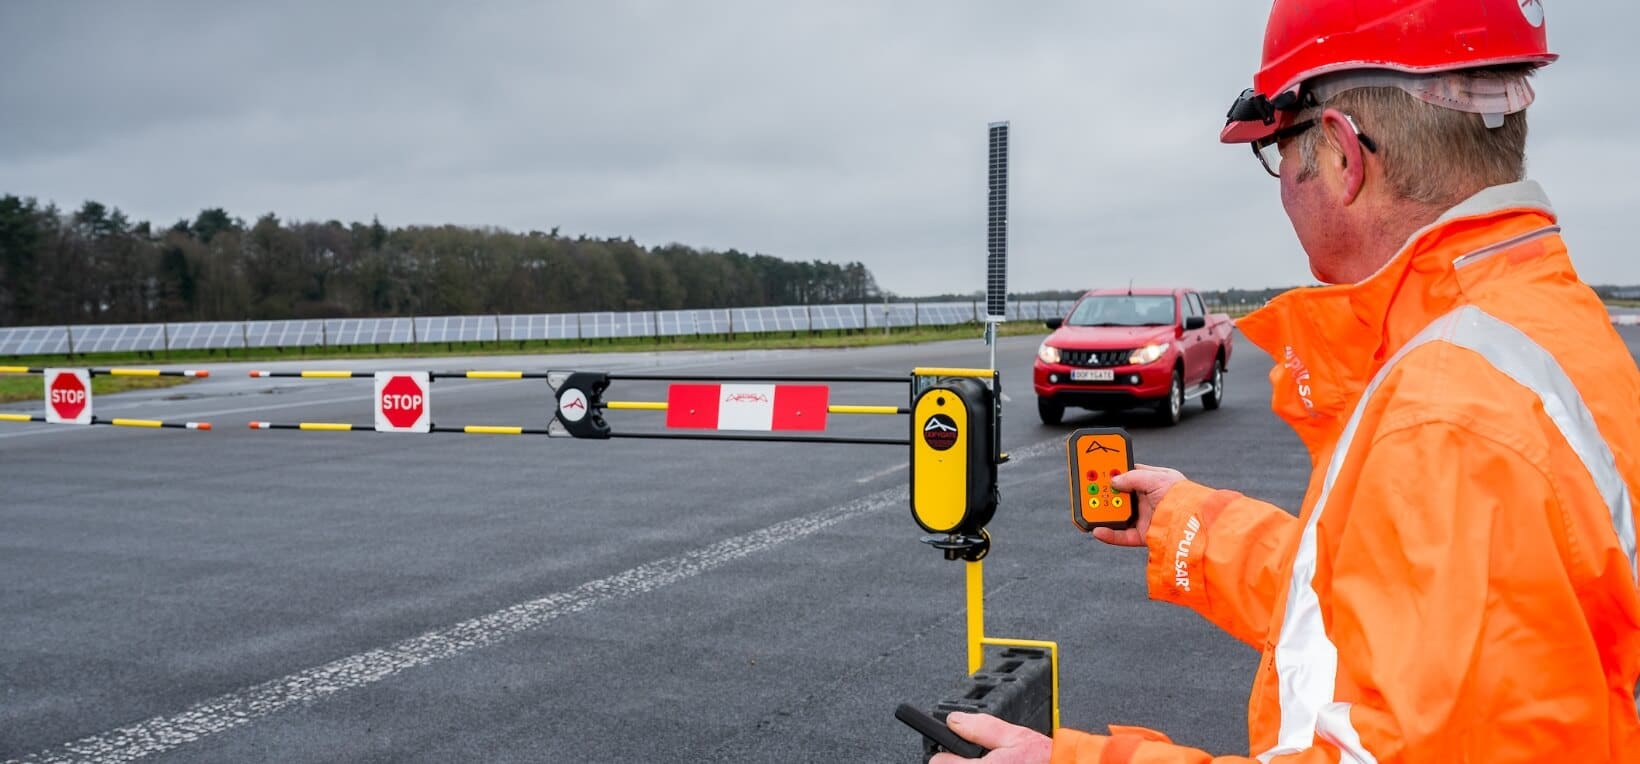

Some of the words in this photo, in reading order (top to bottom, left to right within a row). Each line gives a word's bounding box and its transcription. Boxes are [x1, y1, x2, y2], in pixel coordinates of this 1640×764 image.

[52, 389, 84, 404] STOP
[383, 394, 421, 410] STOP
[1175, 529, 1196, 587] PULSAR
